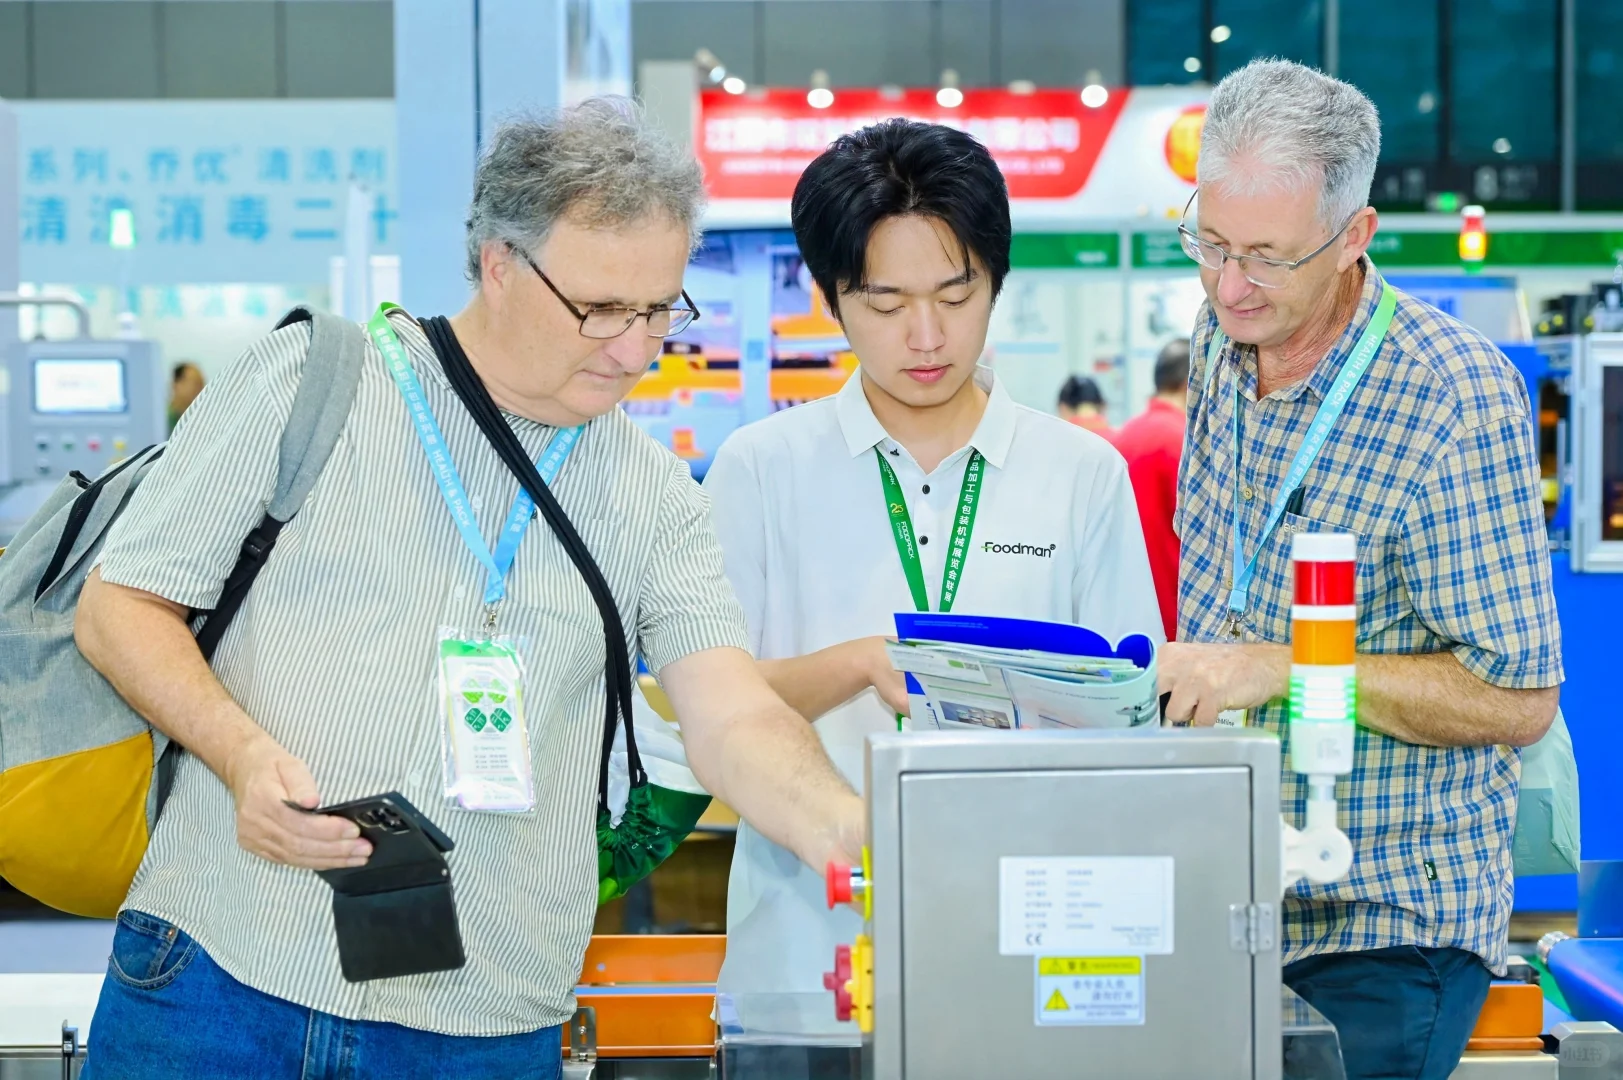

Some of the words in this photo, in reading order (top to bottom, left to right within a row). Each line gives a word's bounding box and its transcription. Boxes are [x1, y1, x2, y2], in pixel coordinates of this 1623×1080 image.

[1352, 334, 1378, 371] HEALTH
[1346, 371, 1357, 383] &
[1330, 380, 1351, 408] PACK
[433, 450, 453, 487] HEALTH
[454, 498, 470, 528] PACK
